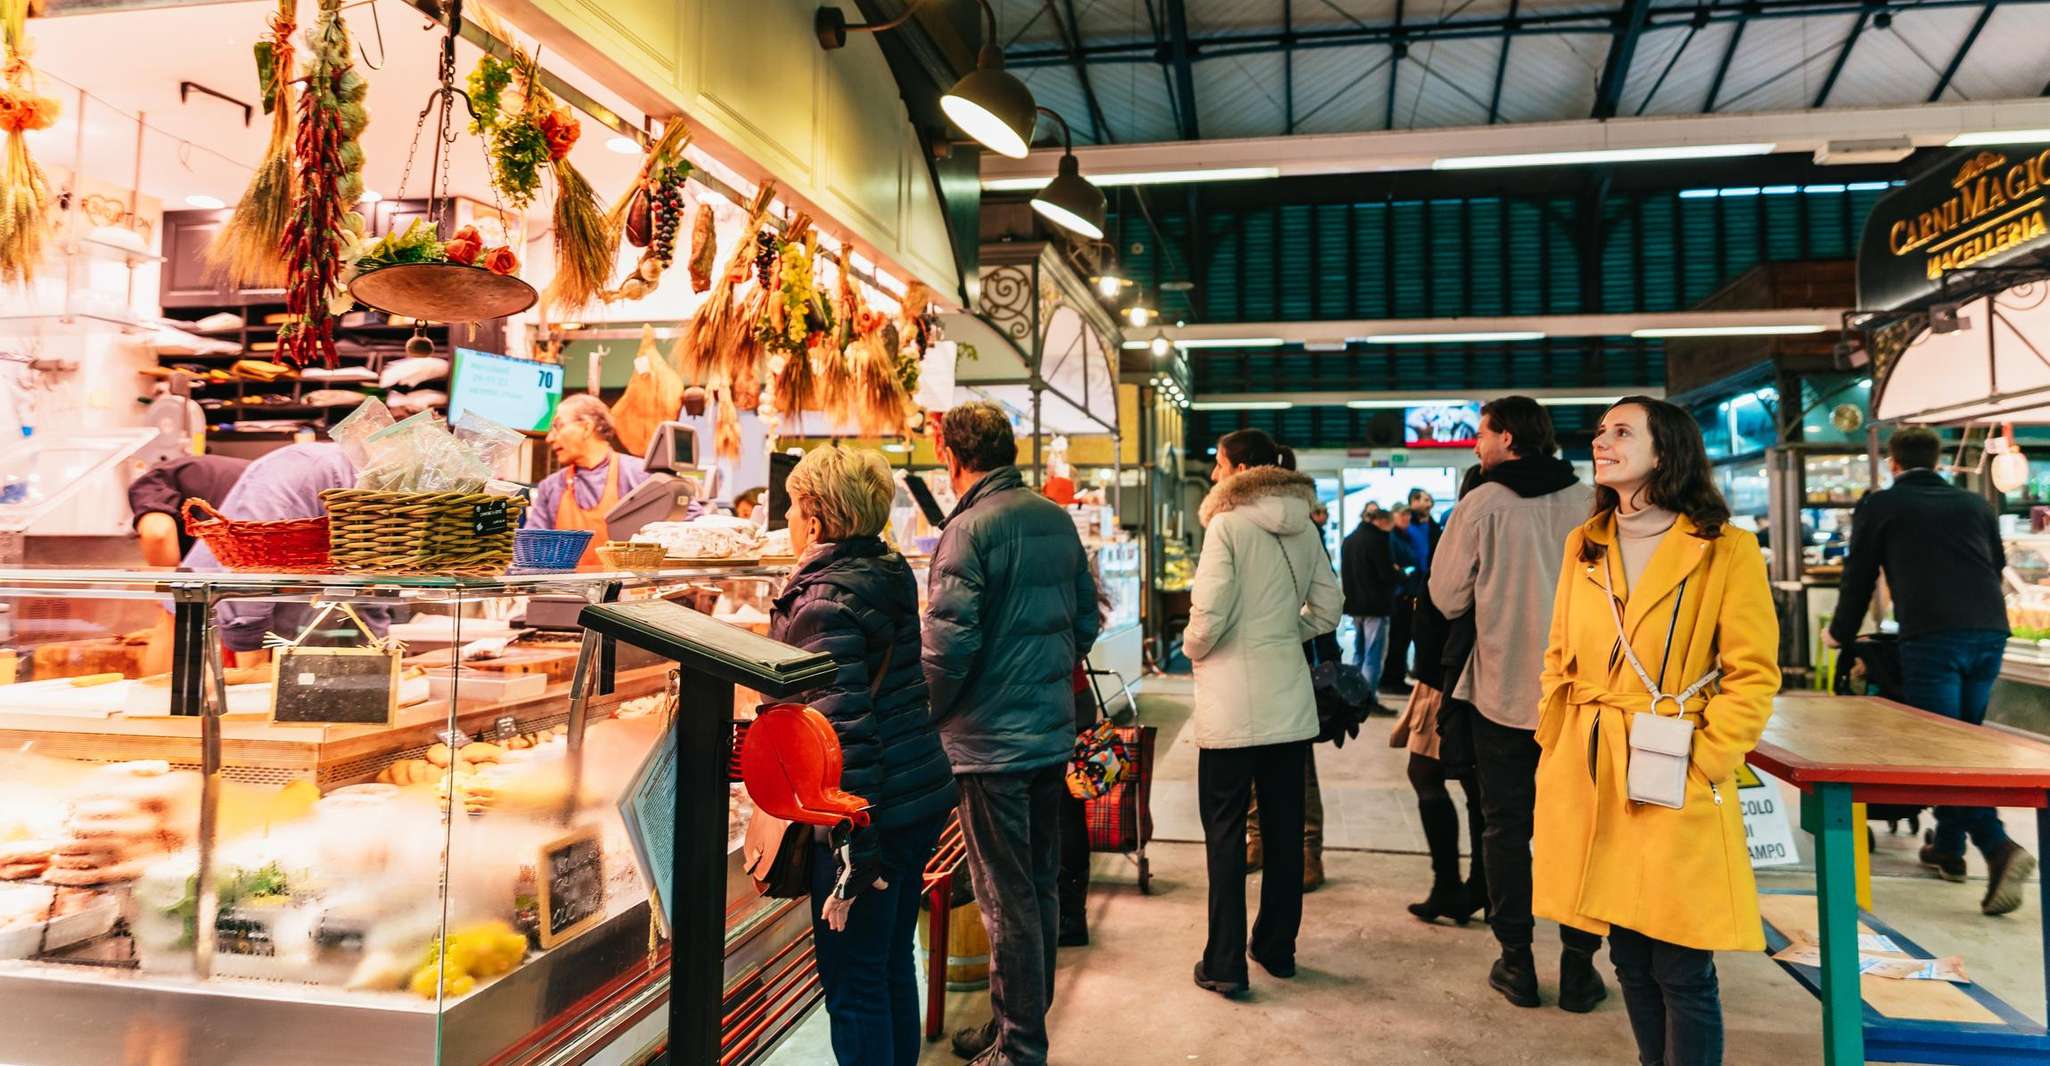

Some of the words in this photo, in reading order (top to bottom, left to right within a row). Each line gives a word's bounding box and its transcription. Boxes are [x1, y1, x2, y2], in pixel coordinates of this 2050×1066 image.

[1890, 197, 1959, 256] CARNI
[1927, 210, 2049, 280] MACELLERIA
[538, 370, 553, 389] 70
